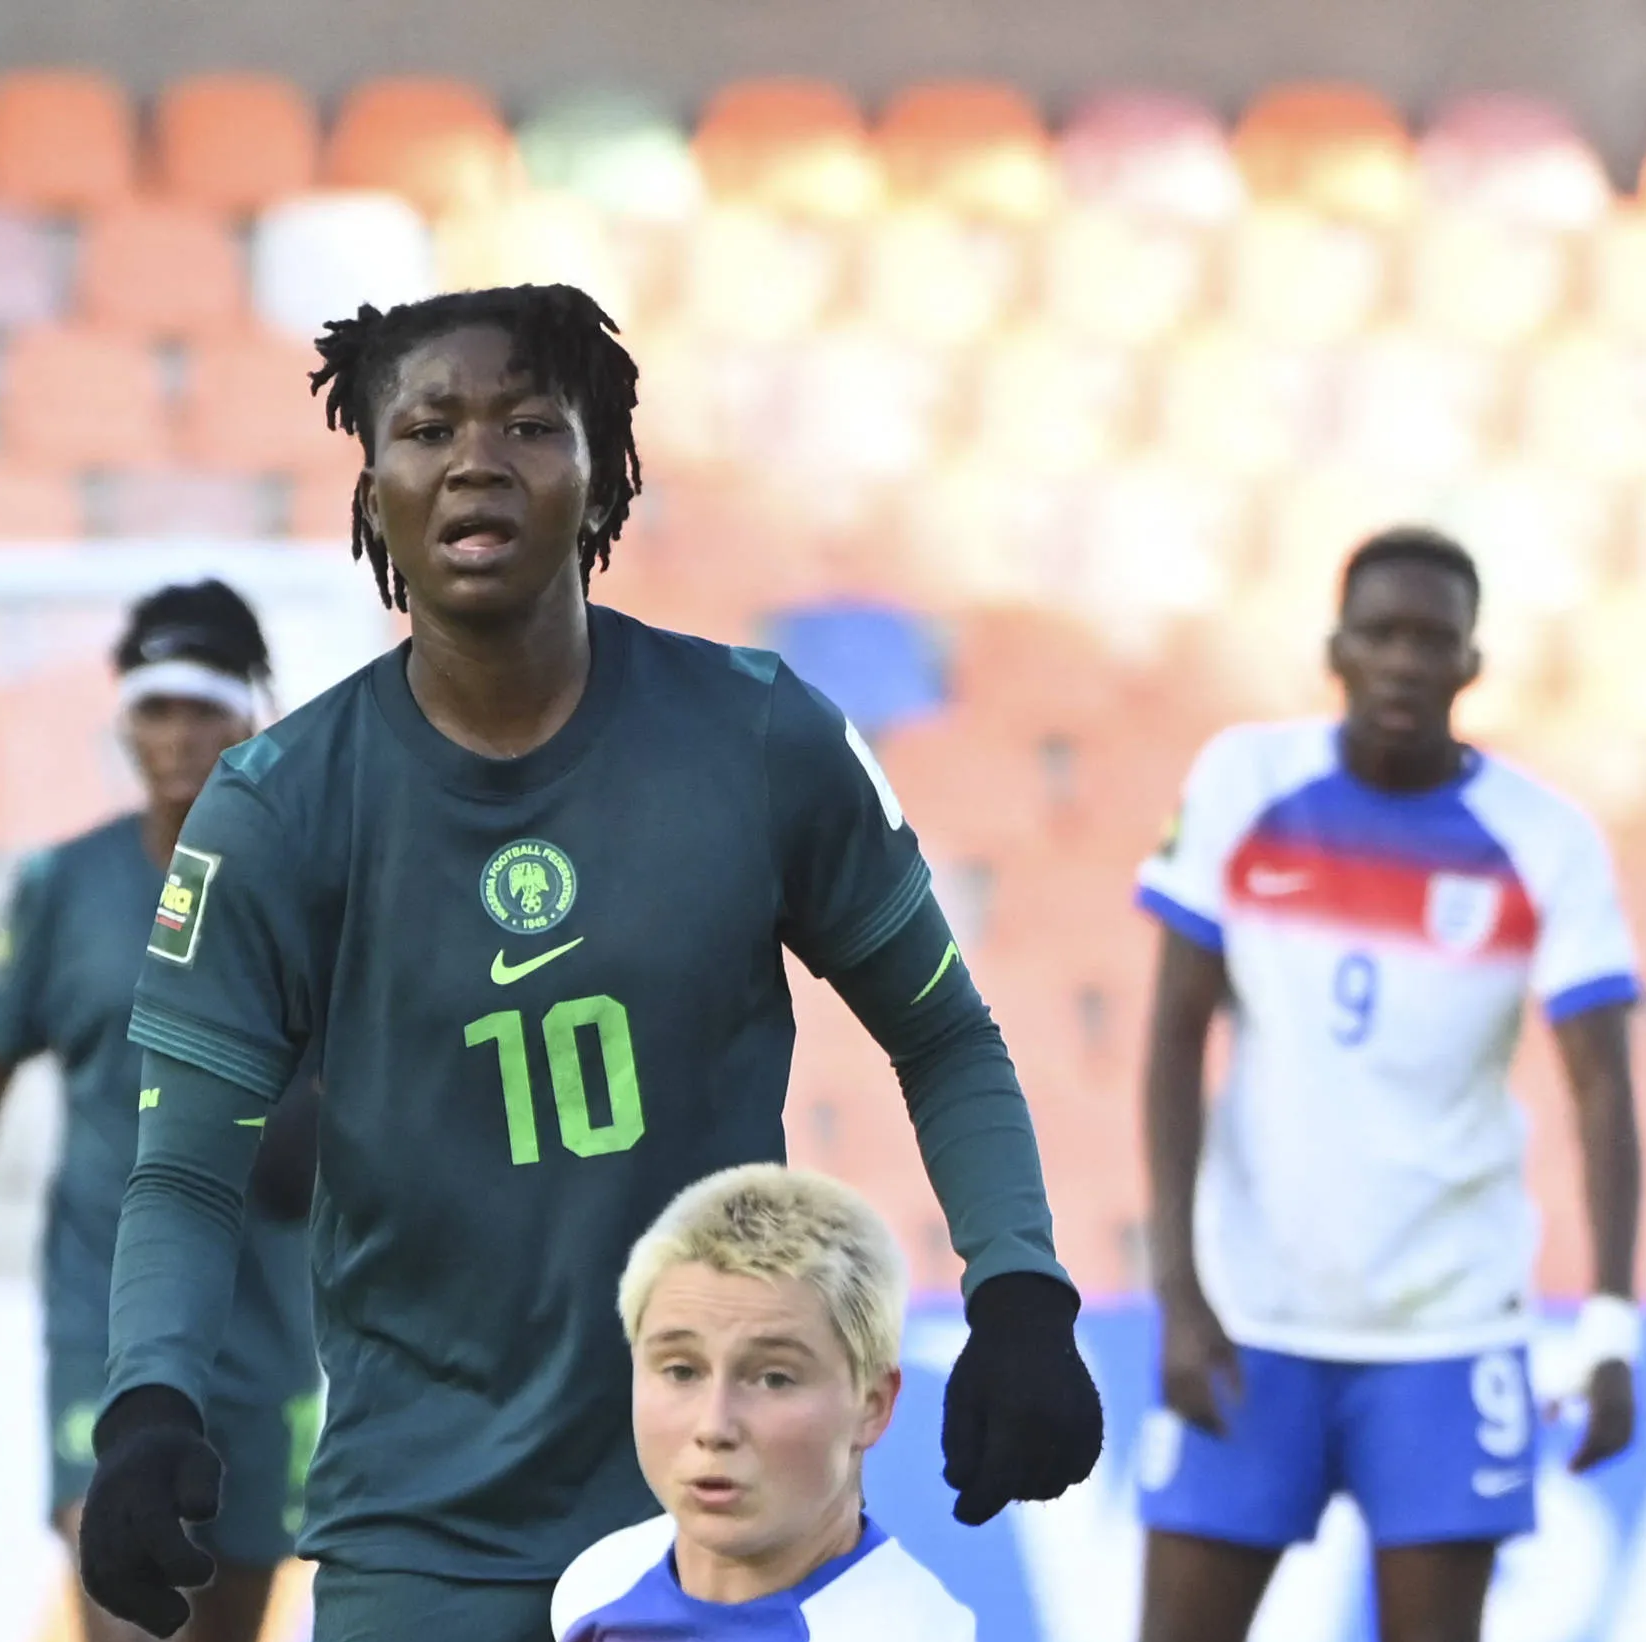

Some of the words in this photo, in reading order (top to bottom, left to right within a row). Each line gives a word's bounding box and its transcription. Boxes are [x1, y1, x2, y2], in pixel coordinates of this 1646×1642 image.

[488, 844, 542, 878] FOOTBALL
[541, 847, 573, 912] FEDERATION
[522, 915, 548, 929] 1945
[1331, 949, 1378, 1051] 9
[463, 993, 646, 1167] 10
[1470, 1350, 1530, 1459] 9
